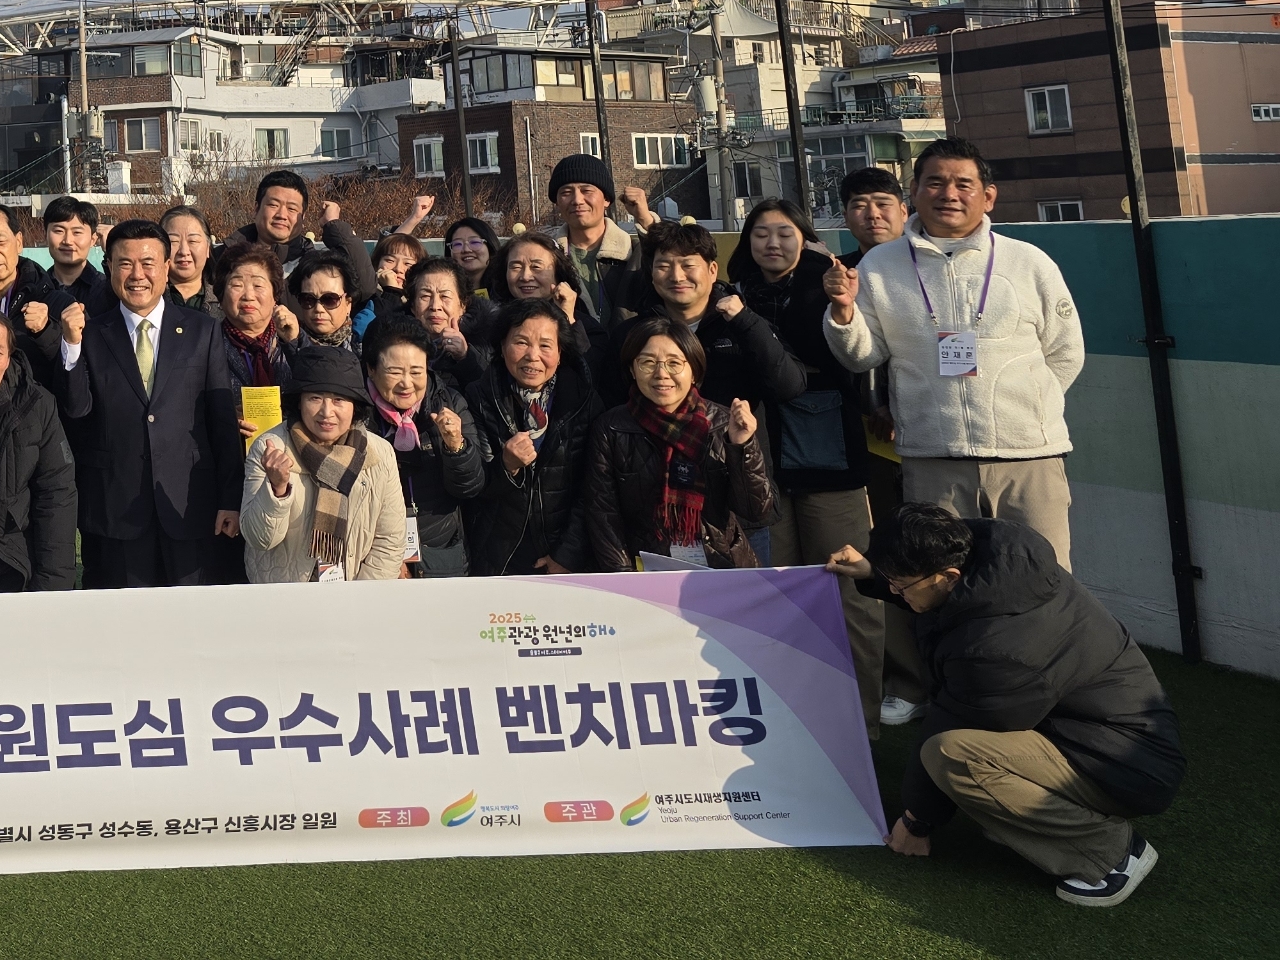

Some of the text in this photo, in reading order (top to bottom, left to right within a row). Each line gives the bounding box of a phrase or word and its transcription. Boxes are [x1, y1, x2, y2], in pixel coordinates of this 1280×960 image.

[488, 612, 522, 624] 2025
[211, 687, 480, 766] 우수사례
[495, 676, 767, 754] 벤치마킹
[654, 790, 762, 806] 여주시도시재생지원센터
[657, 806, 678, 815] Yeoju
[660, 810, 791, 824] Urban Regeneration Support Center
[37, 821, 92, 842] 성동구
[98, 818, 159, 839] 성수동,
[163, 815, 219, 836] 용산구
[223, 812, 297, 834] 신흥시장
[301, 810, 338, 831] 일원
[480, 813, 521, 828] 여주시
